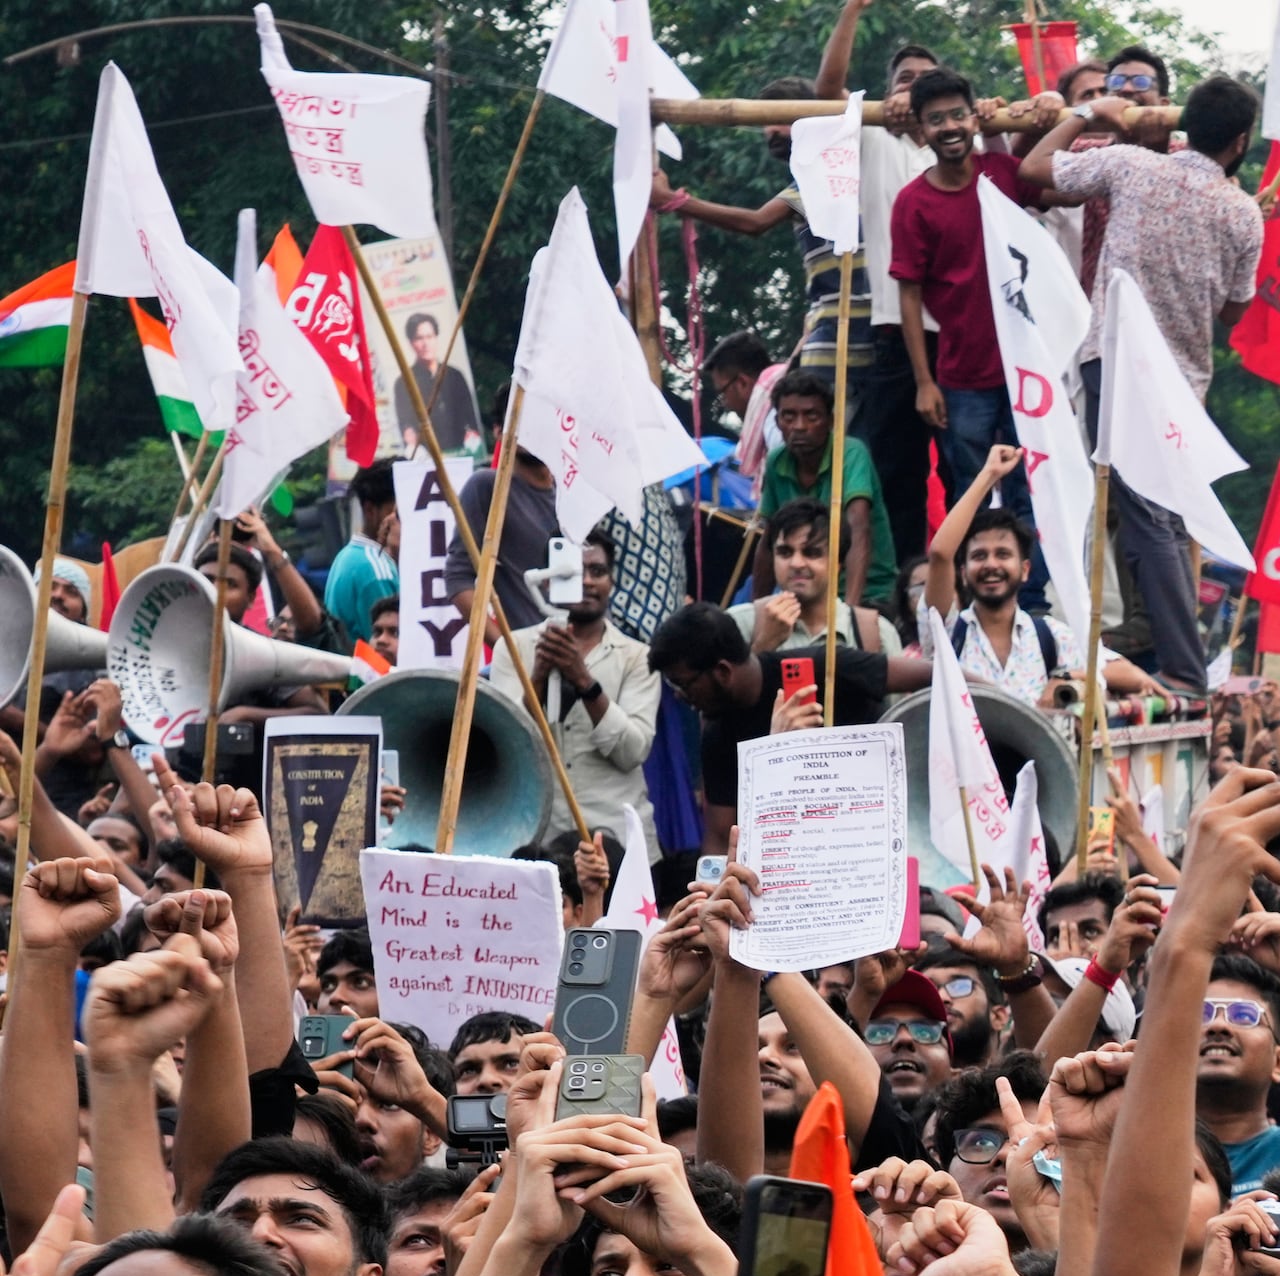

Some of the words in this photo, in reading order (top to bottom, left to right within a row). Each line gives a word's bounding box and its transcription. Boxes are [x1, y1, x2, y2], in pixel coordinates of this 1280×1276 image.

[768, 757, 784, 765] THE
[786, 751, 852, 762] CONSTITUTION
[287, 769, 345, 780] CONSTITUTION
[794, 774, 840, 782] PREAMBLE
[788, 788, 815, 796] PEOPLE
[300, 796, 325, 806] INDIA
[379, 870, 414, 894] An
[421, 873, 518, 900] Educated
[762, 879, 807, 888] FRATERNITY
[795, 900, 844, 910] CONSTITUENT
[381, 906, 427, 927] Mind
[446, 912, 460, 928] is
[481, 913, 513, 931] the
[386, 939, 464, 963] Greatest
[474, 947, 540, 971] Weapon
[389, 975, 453, 998] against
[463, 975, 555, 1005] INJUSTICE
